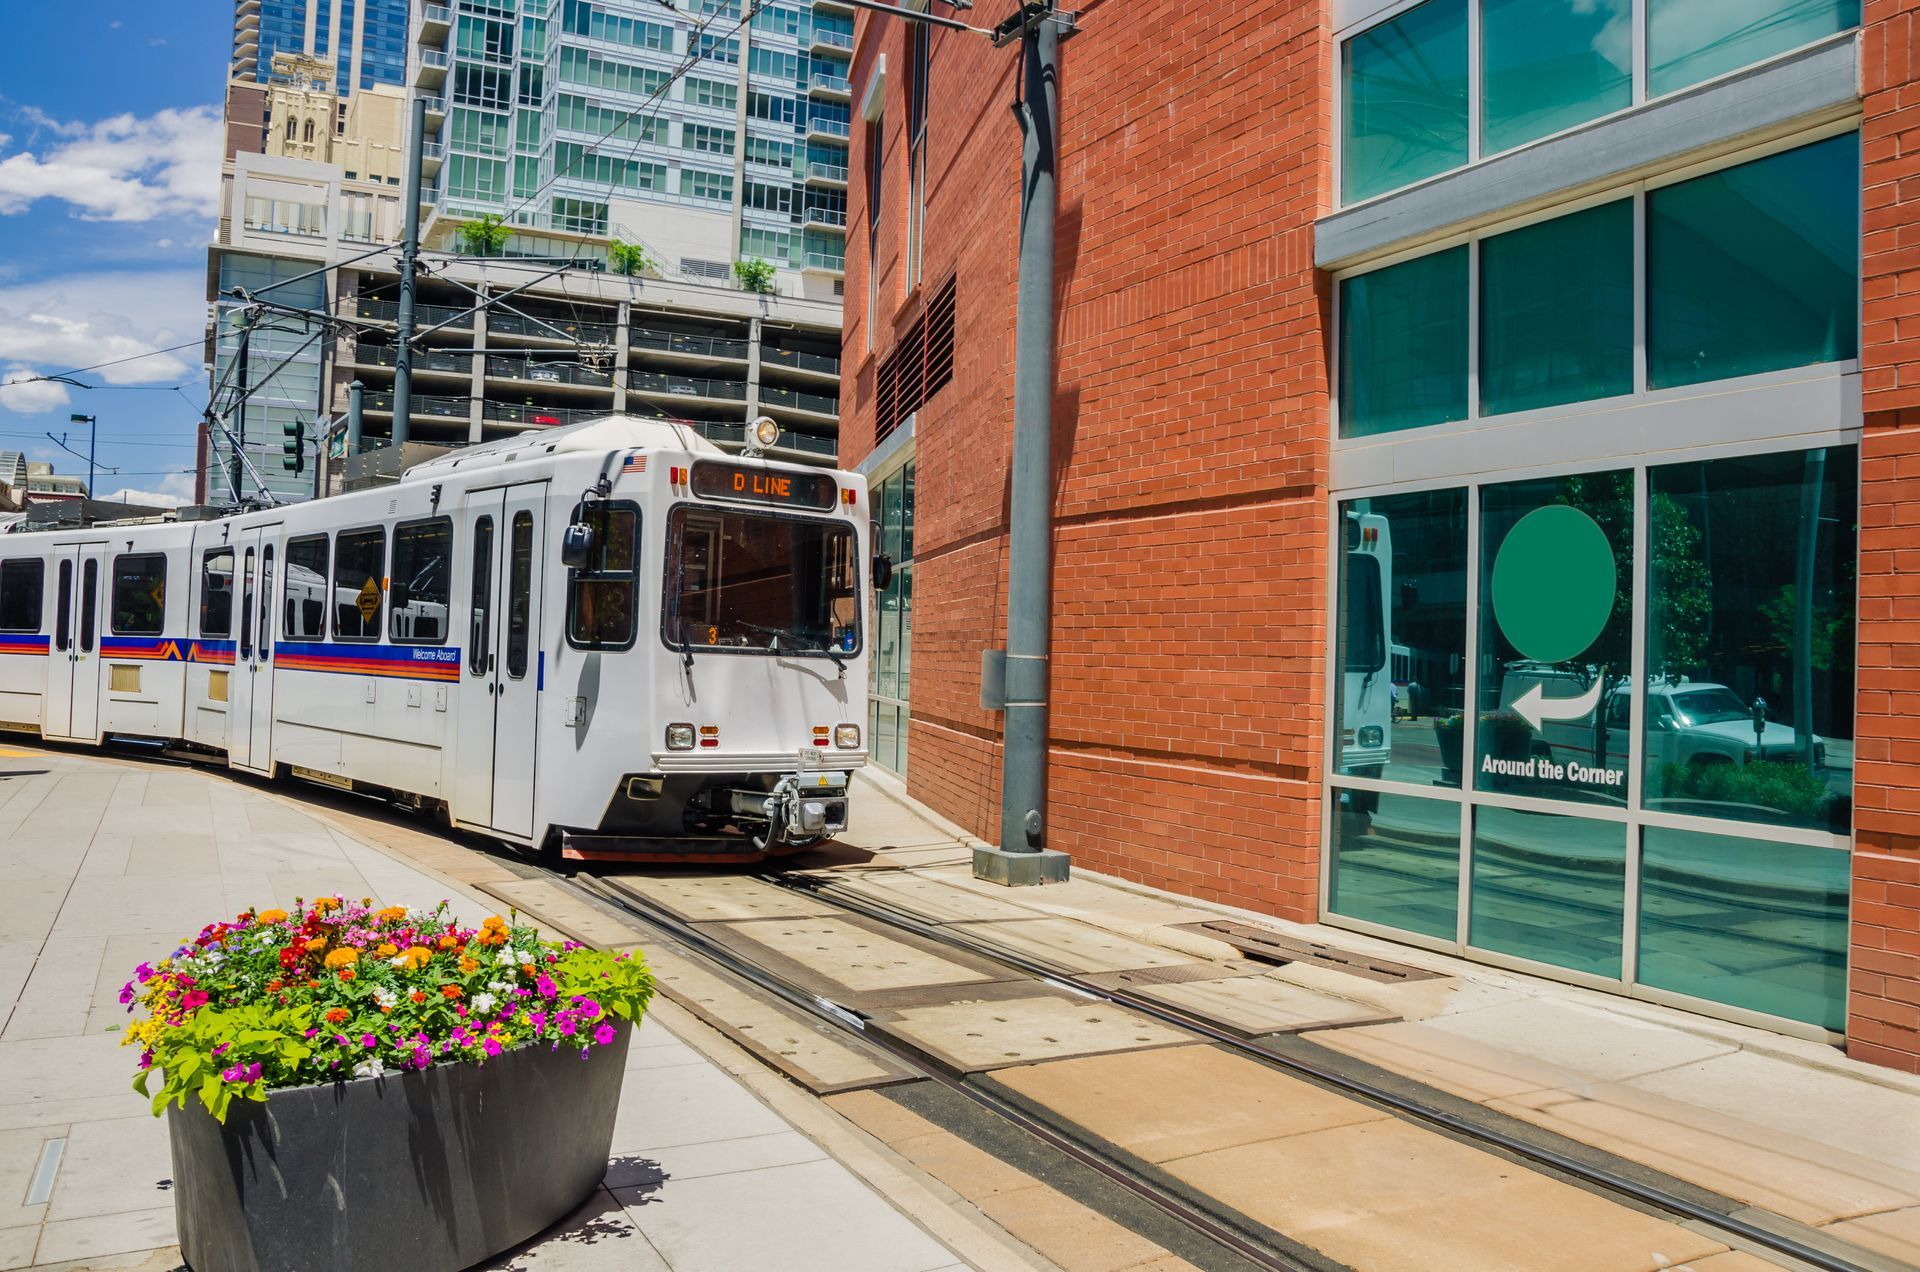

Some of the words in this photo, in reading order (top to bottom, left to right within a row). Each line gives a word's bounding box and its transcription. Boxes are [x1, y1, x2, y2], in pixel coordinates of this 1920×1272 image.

[734, 473, 745, 491] D
[753, 475, 791, 497] LINE
[708, 626, 718, 645] 3
[412, 648, 436, 660] Welcome
[436, 649, 457, 661] Aboard
[1482, 754, 1535, 777] Around
[1538, 759, 1564, 780] the
[1567, 761, 1624, 786] Corner
